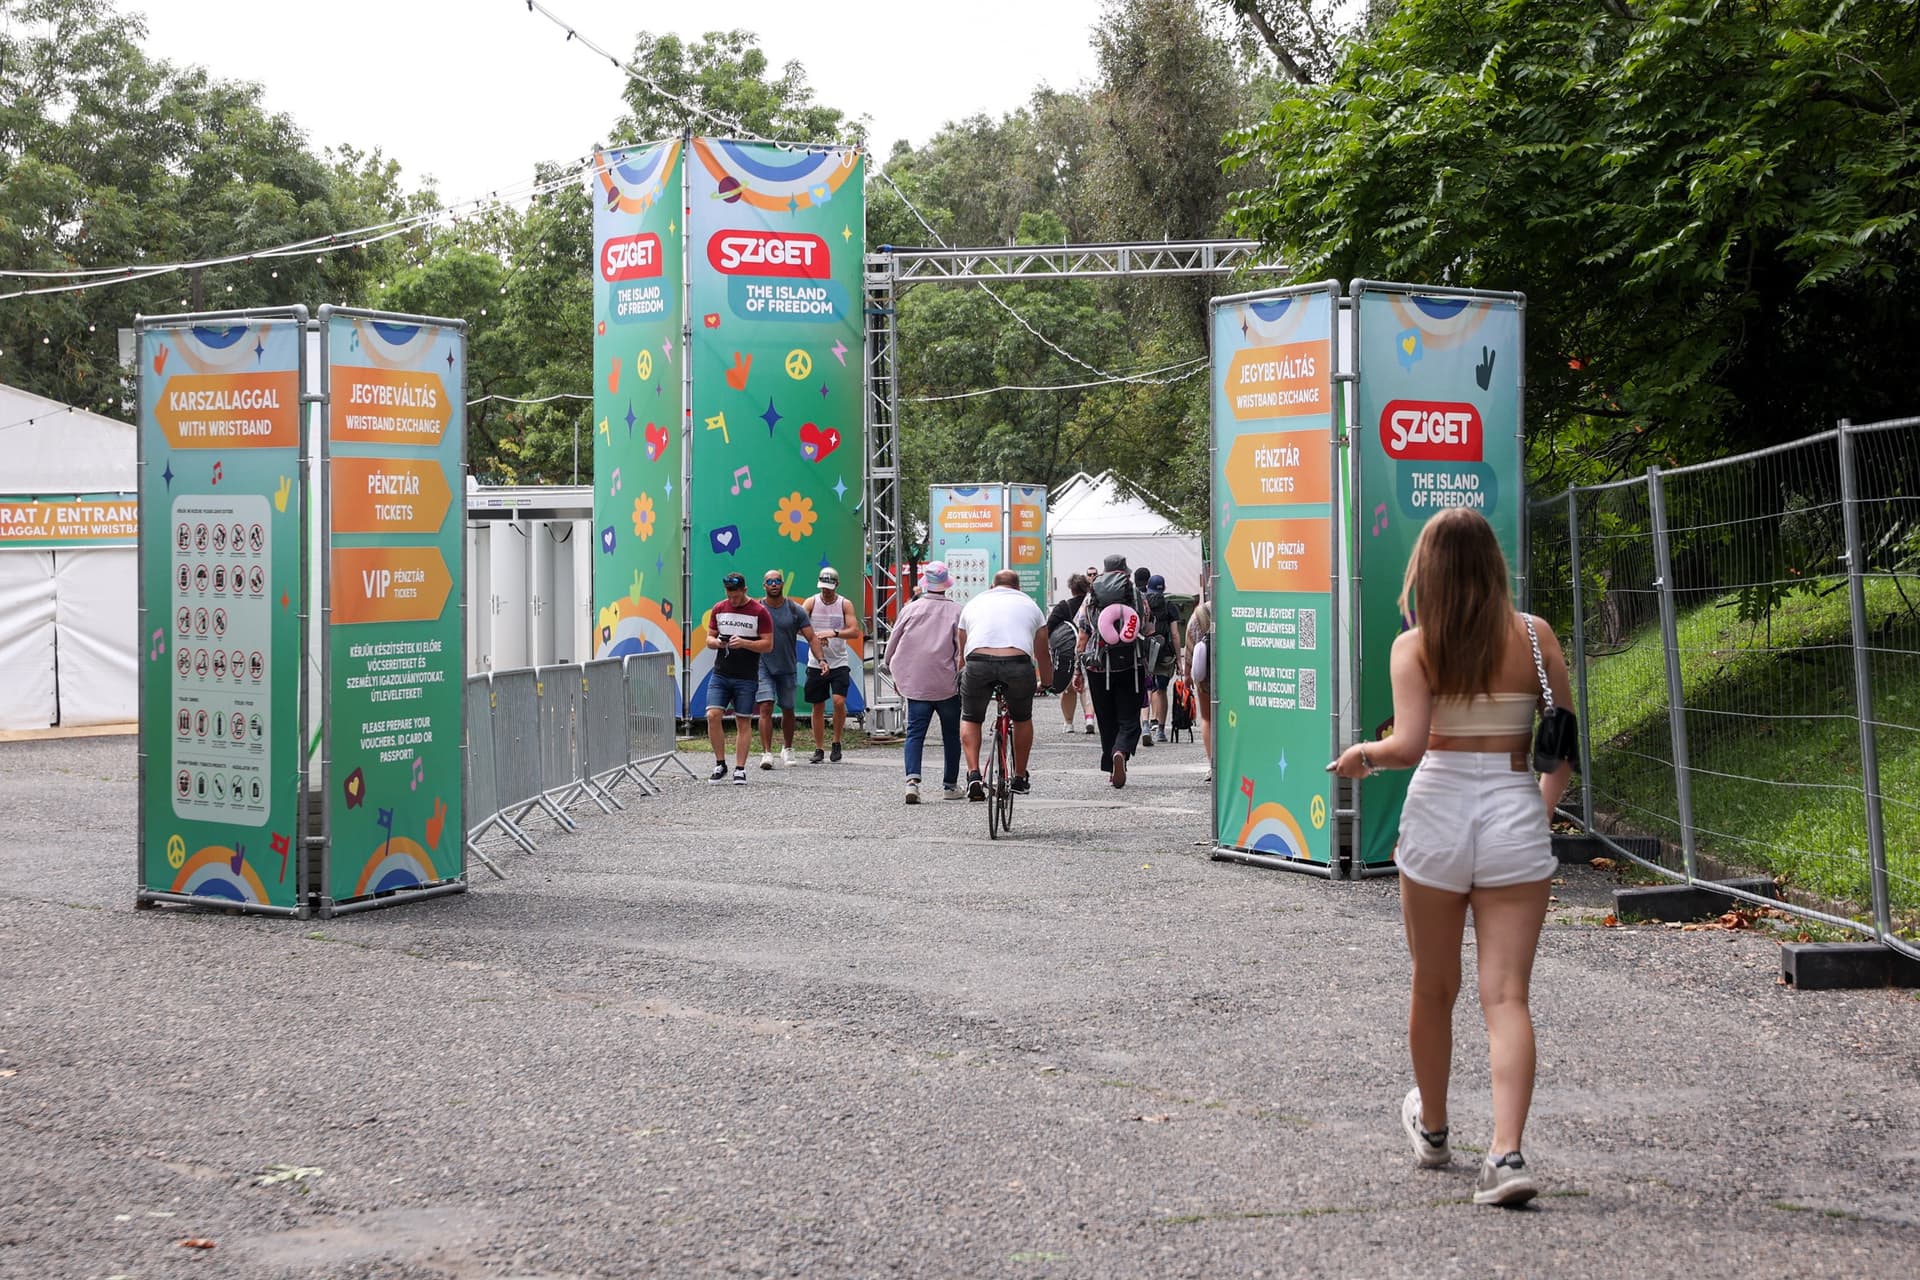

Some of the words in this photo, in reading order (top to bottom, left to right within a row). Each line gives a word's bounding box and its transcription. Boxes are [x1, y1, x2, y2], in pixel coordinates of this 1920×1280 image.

[618, 290, 632, 302] THE
[632, 286, 660, 300] ISLAND
[746, 285, 772, 298] THE
[776, 286, 826, 300] ISLAND
[618, 303, 628, 316] OF
[628, 300, 664, 314] FREEDOM
[746, 299, 765, 312] OF
[768, 300, 832, 314] FREEDOM
[1240, 354, 1315, 384] JEGYBEVÁLTÁS
[170, 388, 280, 411] KARSZALAGGAL
[350, 382, 437, 408] JEGYBEVÁLTÁS
[1236, 392, 1277, 408] WRISTBAND
[1278, 388, 1320, 405] EXCHANGE
[178, 420, 206, 437] WITH
[208, 420, 272, 436] WRISTBAND
[346, 415, 396, 432] WRISTBAND
[396, 417, 440, 433] EXCHANGE
[1255, 443, 1300, 468] PÉNZTÁR
[368, 470, 419, 495] PÉNZTÁR
[1261, 477, 1294, 492] TICKETS
[1412, 473, 1434, 488] THE
[1436, 474, 1480, 490] ISLAND
[1412, 490, 1428, 507] OF
[1430, 492, 1484, 508] FREEDOM
[375, 504, 413, 520] TICKETS
[0, 526, 48, 536] LAGGAL
[58, 525, 88, 536] WITH
[1250, 542, 1274, 568] VIP
[362, 570, 391, 598] VIP
[1264, 608, 1268, 618] A
[1124, 614, 1138, 640] Coke
[1241, 636, 1246, 648] A
[418, 655, 426, 668] ÉS
[1244, 666, 1260, 676] GRAB
[1260, 667, 1276, 678] YOUR
[1276, 668, 1296, 680] TICKET
[1248, 680, 1262, 691] WITH
[1262, 682, 1267, 692] A
[1268, 682, 1296, 694] DISCOUNT
[1248, 696, 1255, 706] IN
[1256, 696, 1267, 708] OUR
[362, 721, 386, 734] PLEASE
[386, 718, 412, 732] PREPARE
[414, 717, 431, 729] YOUR
[398, 735, 404, 746] ID
[406, 733, 422, 744] CARD
[424, 732, 432, 742] OR
